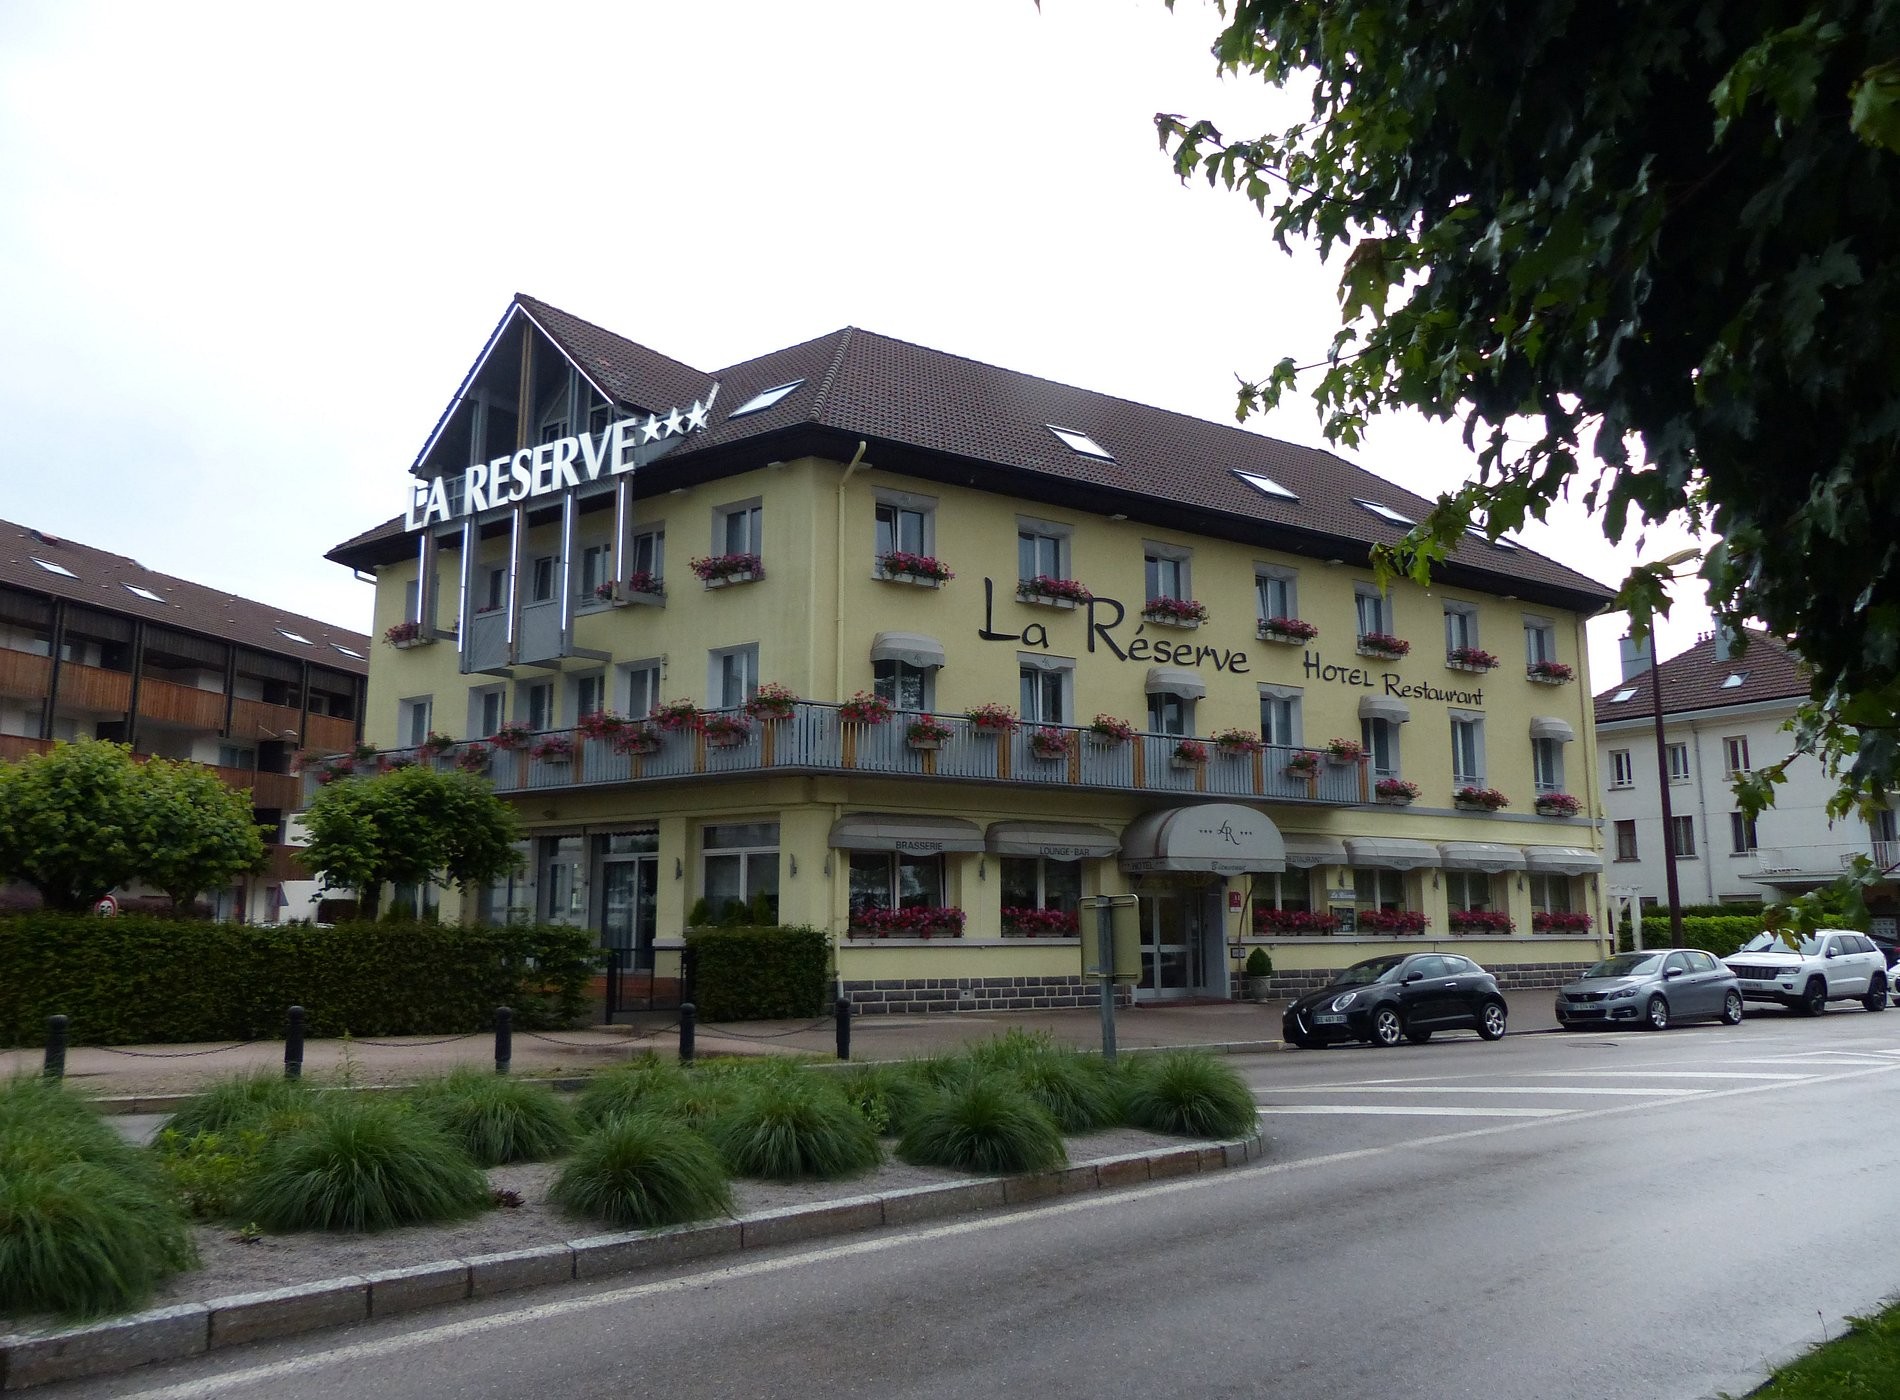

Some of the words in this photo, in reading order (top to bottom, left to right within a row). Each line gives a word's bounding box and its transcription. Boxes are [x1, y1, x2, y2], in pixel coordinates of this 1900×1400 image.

[405, 476, 450, 532] LA
[464, 417, 637, 516] RESERVE
[978, 576, 1050, 649] La
[1086, 597, 1250, 674] Réserve
[1381, 673, 1484, 706] Restaurant
[895, 840, 943, 851] BRASSERIE
